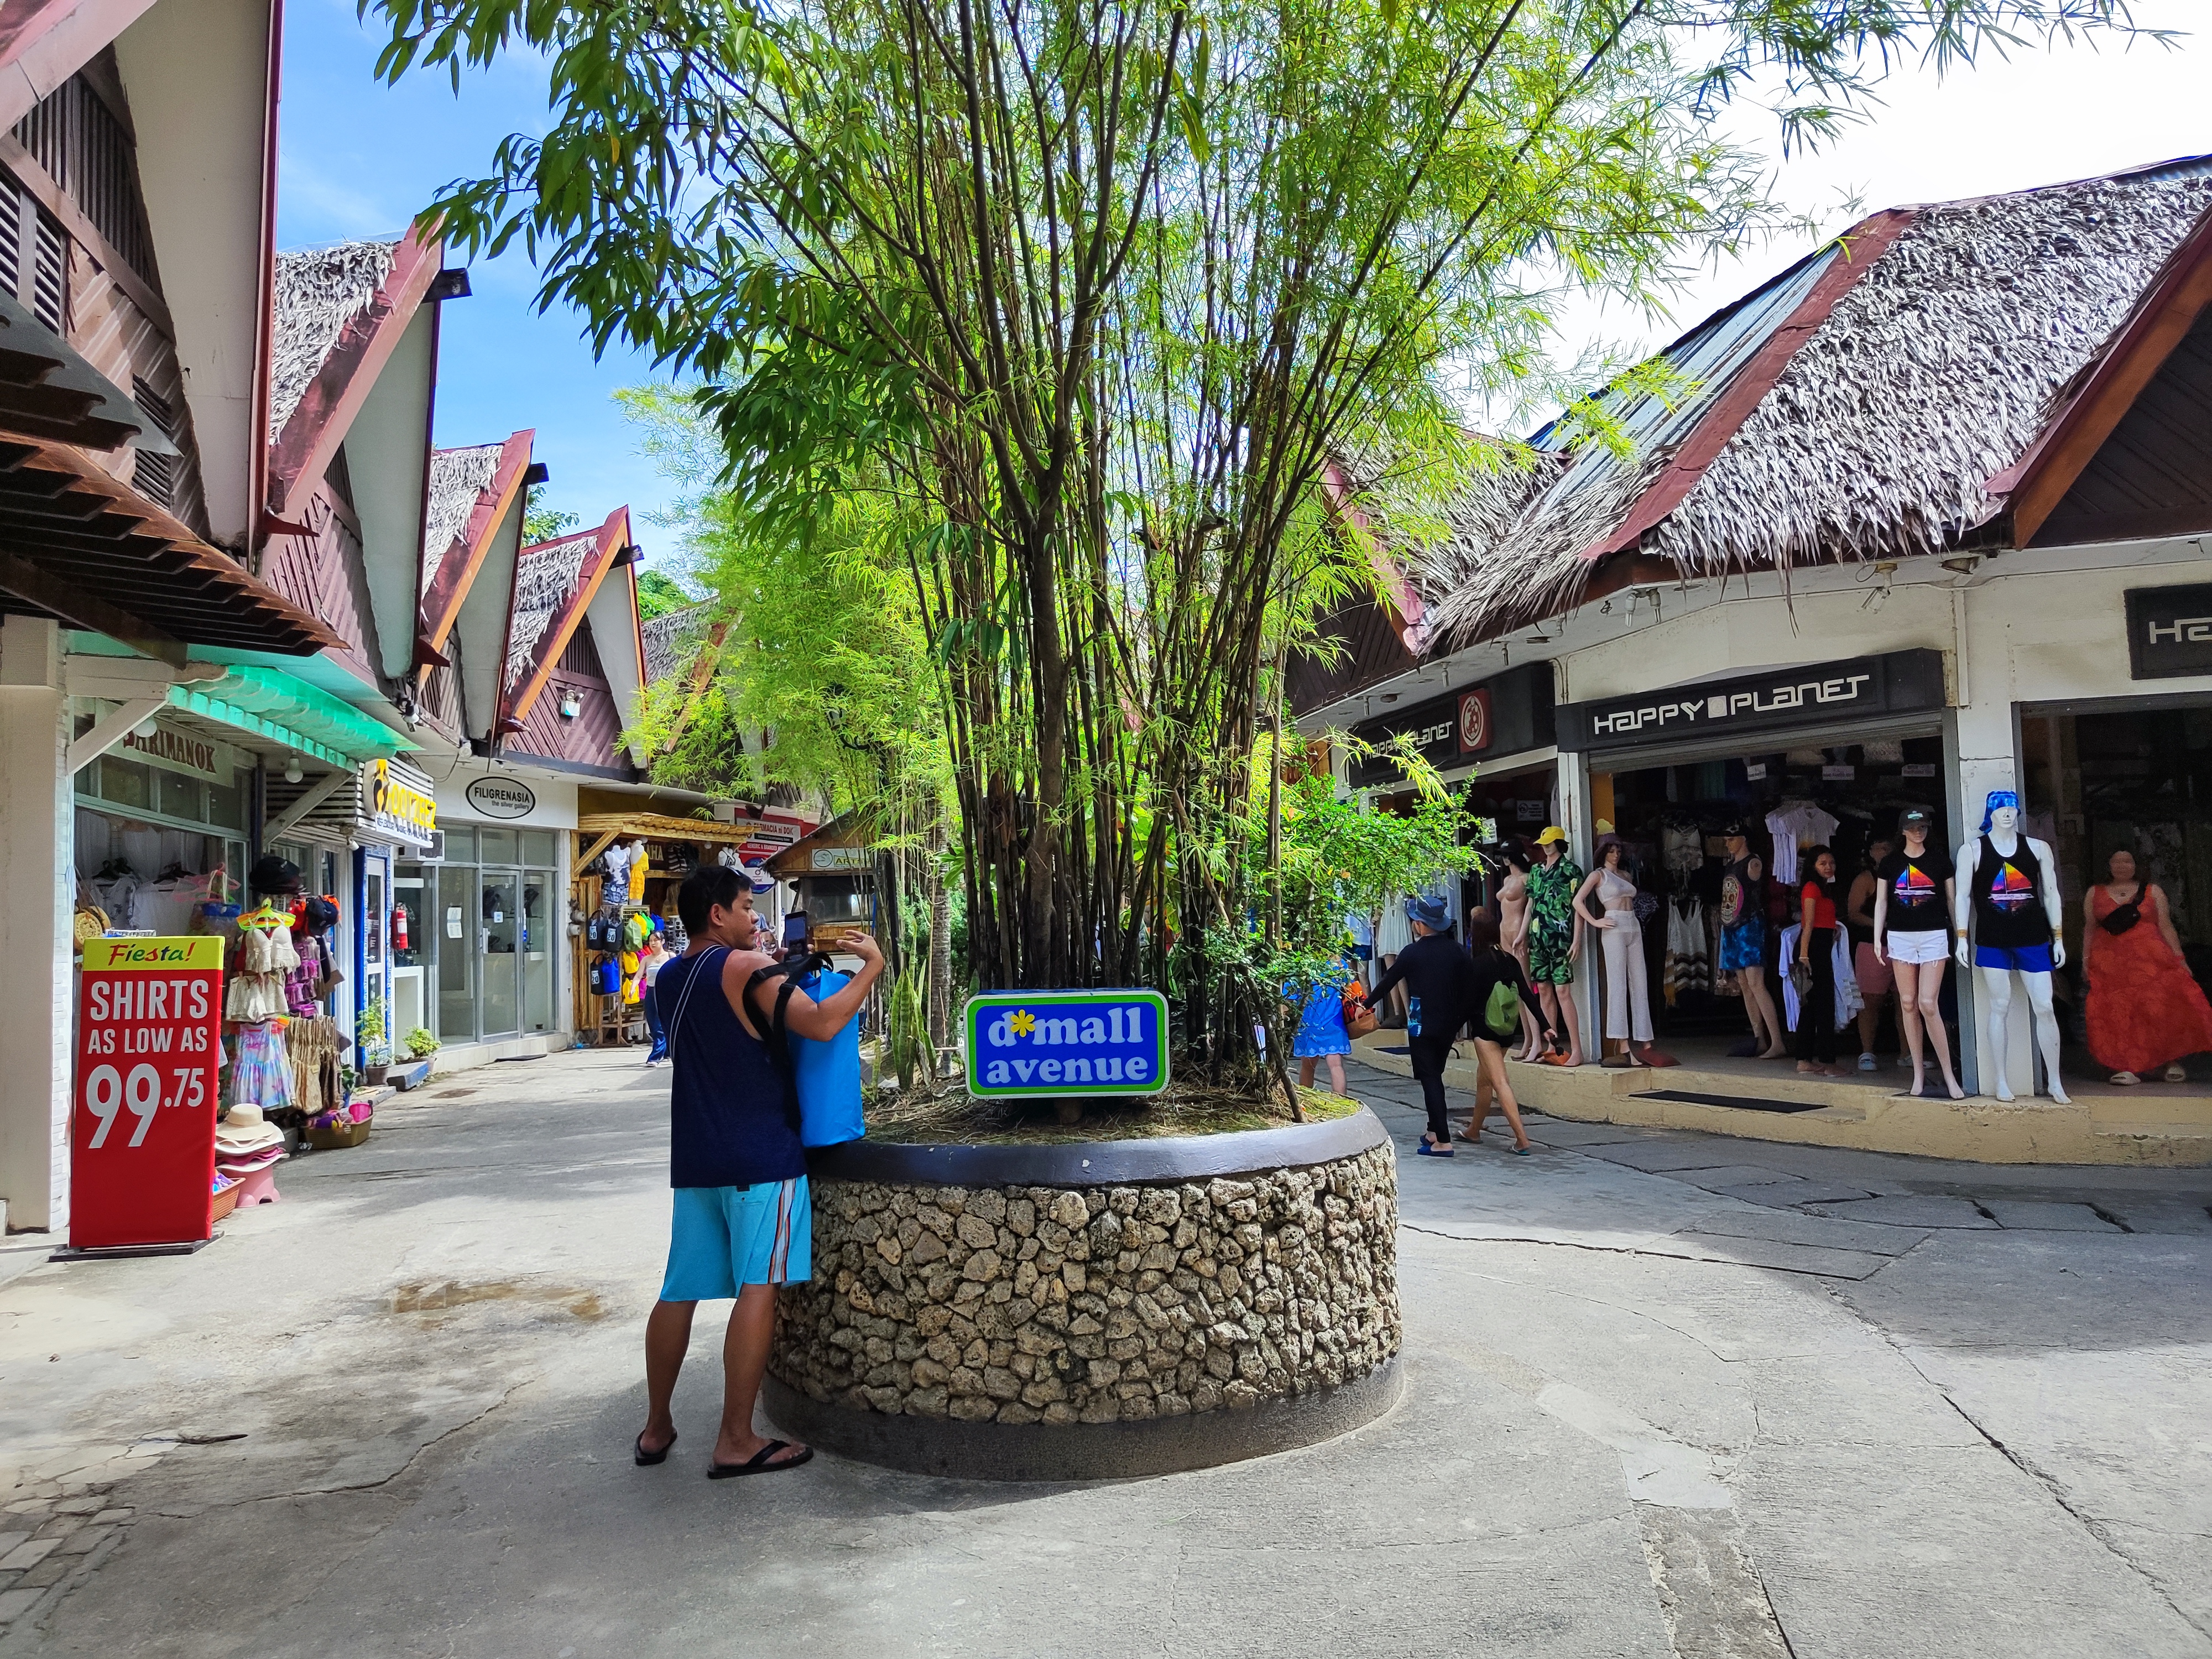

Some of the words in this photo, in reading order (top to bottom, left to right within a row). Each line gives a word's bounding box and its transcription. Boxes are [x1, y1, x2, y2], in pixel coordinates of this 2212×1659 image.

[474, 786, 530, 804] FILIGRENASIA
[108, 942, 196, 966] Fiesta!
[90, 979, 208, 1021] SHIRTS
[87, 1029, 116, 1055] AS
[124, 1027, 174, 1053] LOW
[180, 1026, 207, 1052] AS
[987, 1057, 1149, 1084] avenue
